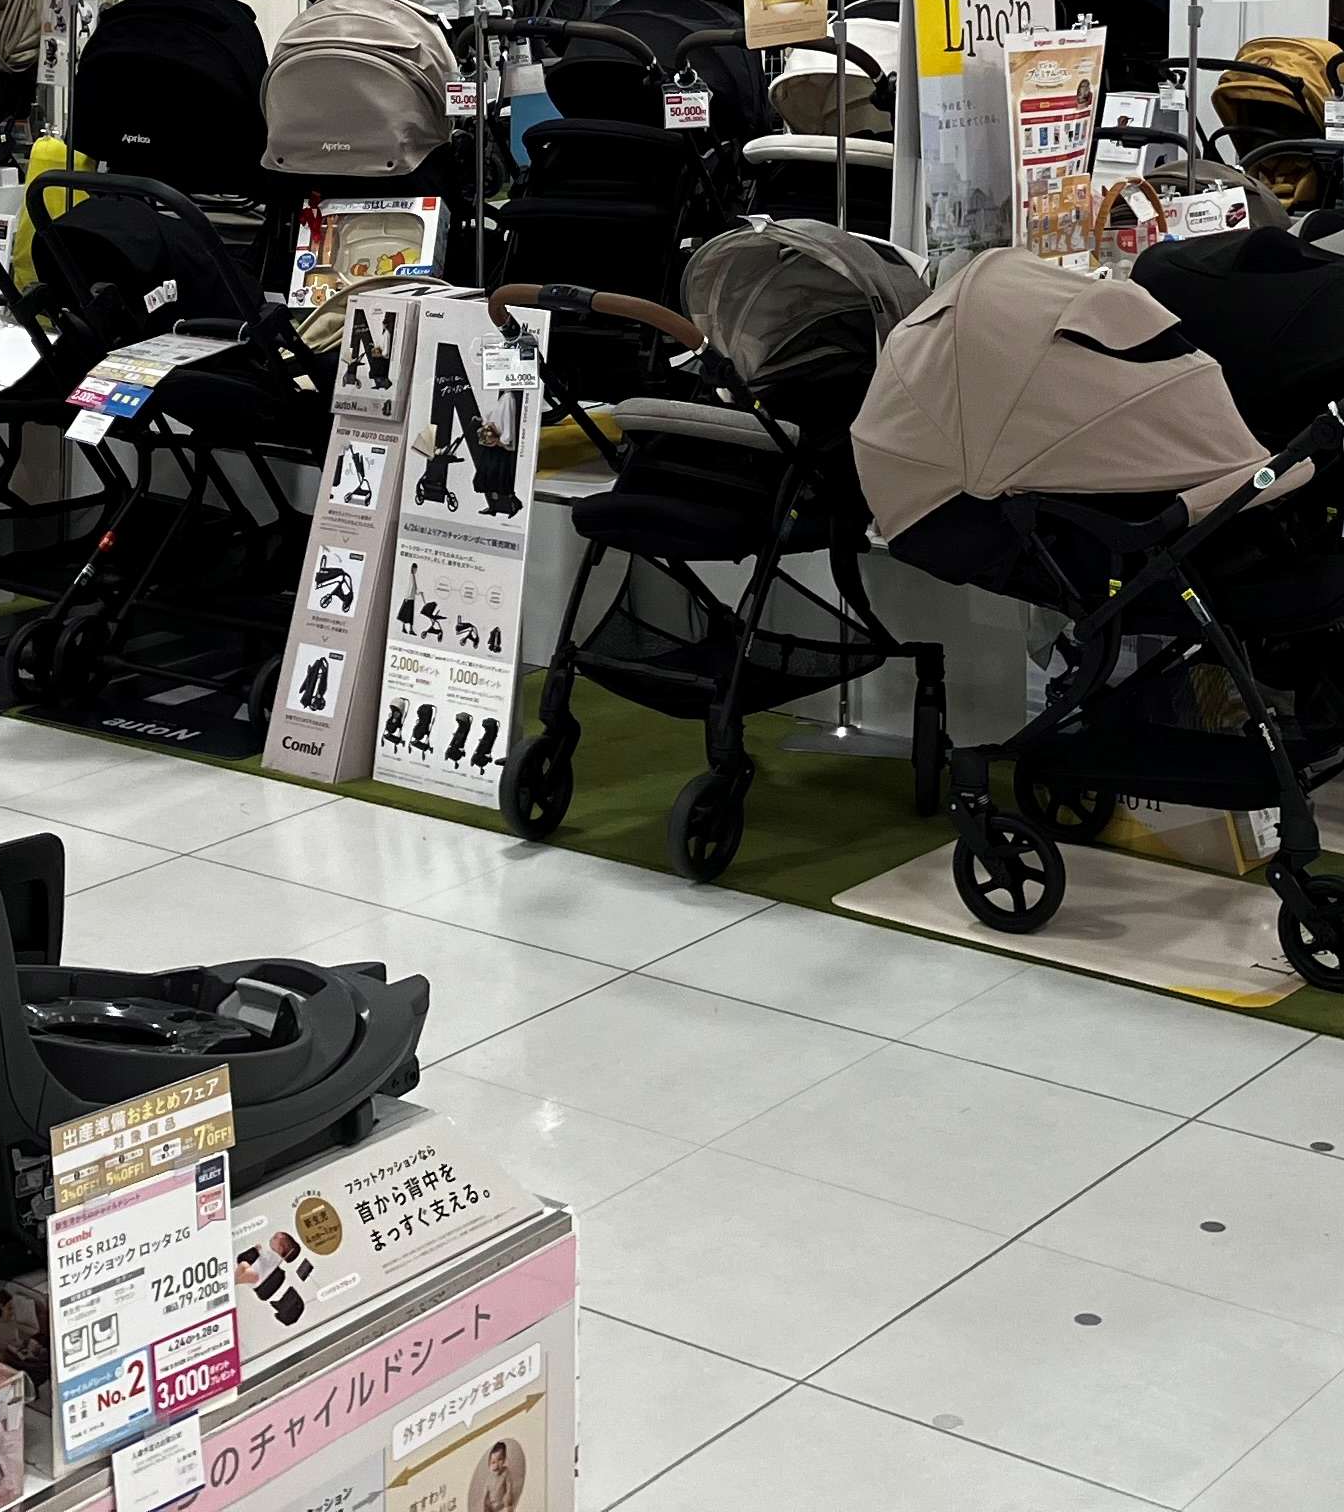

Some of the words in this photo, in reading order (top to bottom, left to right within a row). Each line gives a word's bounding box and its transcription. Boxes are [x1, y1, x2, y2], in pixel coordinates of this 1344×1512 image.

[122, 133, 151, 145] Aprica
[321, 140, 352, 153] Aprica
[425, 310, 445, 319] Combi
[336, 427, 348, 437] HOW
[349, 429, 361, 438] TO
[362, 431, 377, 440] AUTO
[102, 715, 202, 743] autoN
[281, 734, 326, 757] Combi
[62, 1077, 220, 1150] 出産準備おまとめフェア
[197, 1169, 223, 1184] SELECT
[344, 1145, 437, 1195] フラットクッションなら
[354, 1163, 456, 1225] 首から背中を
[369, 1184, 492, 1252] まっすぐ支える。
[56, 1226, 94, 1249] Combi
[57, 1249, 83, 1270] THE
[85, 1245, 94, 1259] S
[96, 1232, 127, 1253] R129
[59, 1247, 136, 1289] エッグショック
[139, 1233, 172, 1257] ロッタ
[174, 1226, 191, 1244] ZG
[157, 1364, 210, 1410] 3,000
